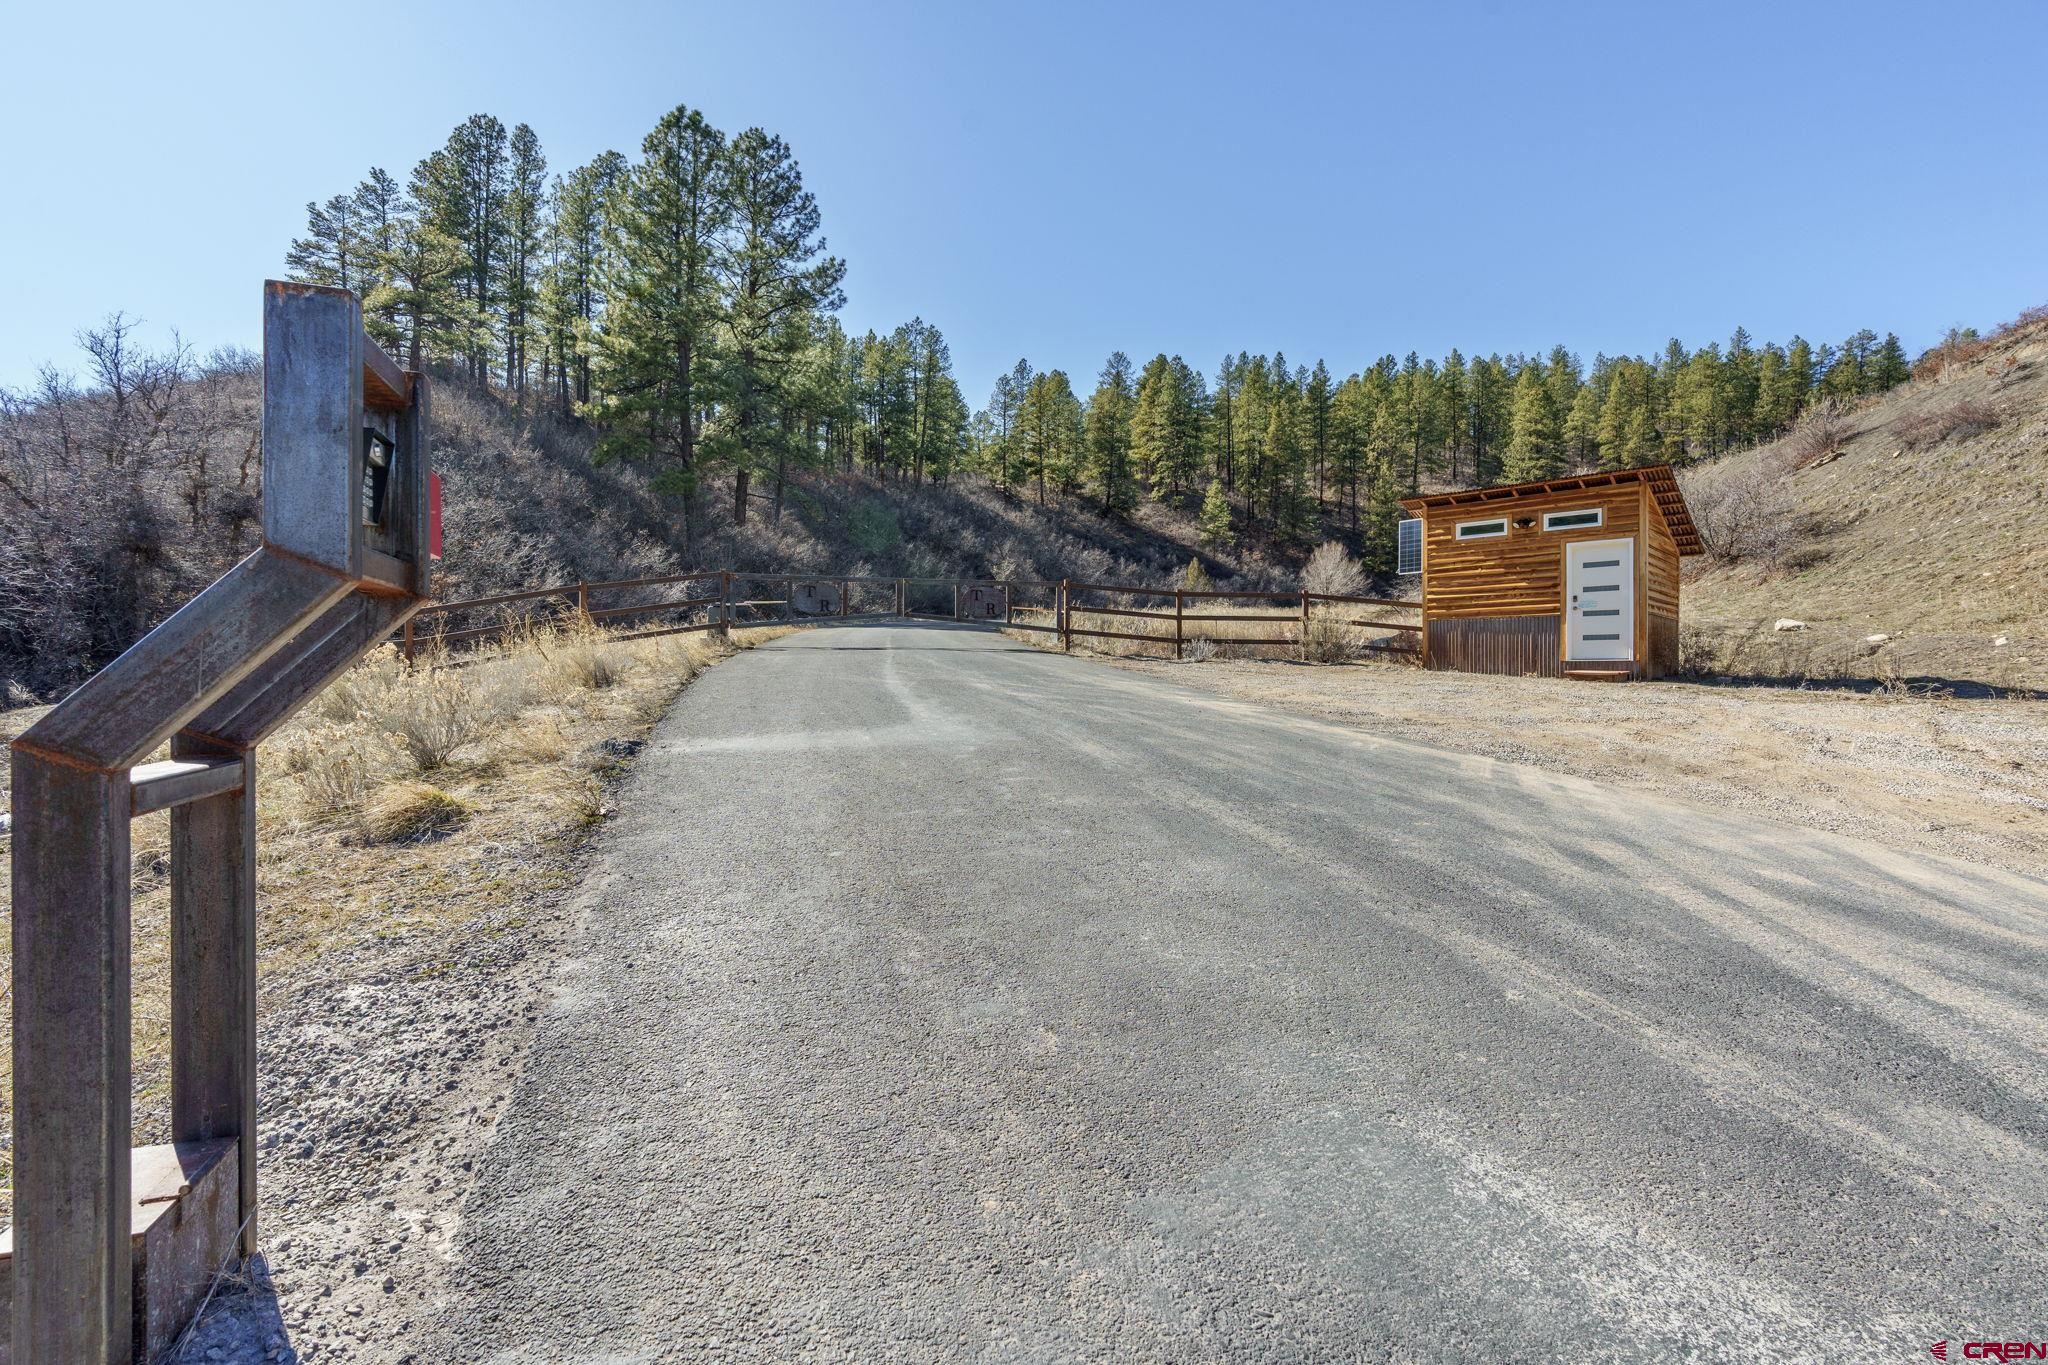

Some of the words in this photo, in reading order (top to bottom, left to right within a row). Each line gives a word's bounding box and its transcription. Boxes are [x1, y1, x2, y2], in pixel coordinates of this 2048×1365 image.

[804, 585, 817, 597] T
[970, 590, 983, 601] T
[819, 599, 830, 612] R
[985, 603, 996, 615] R
